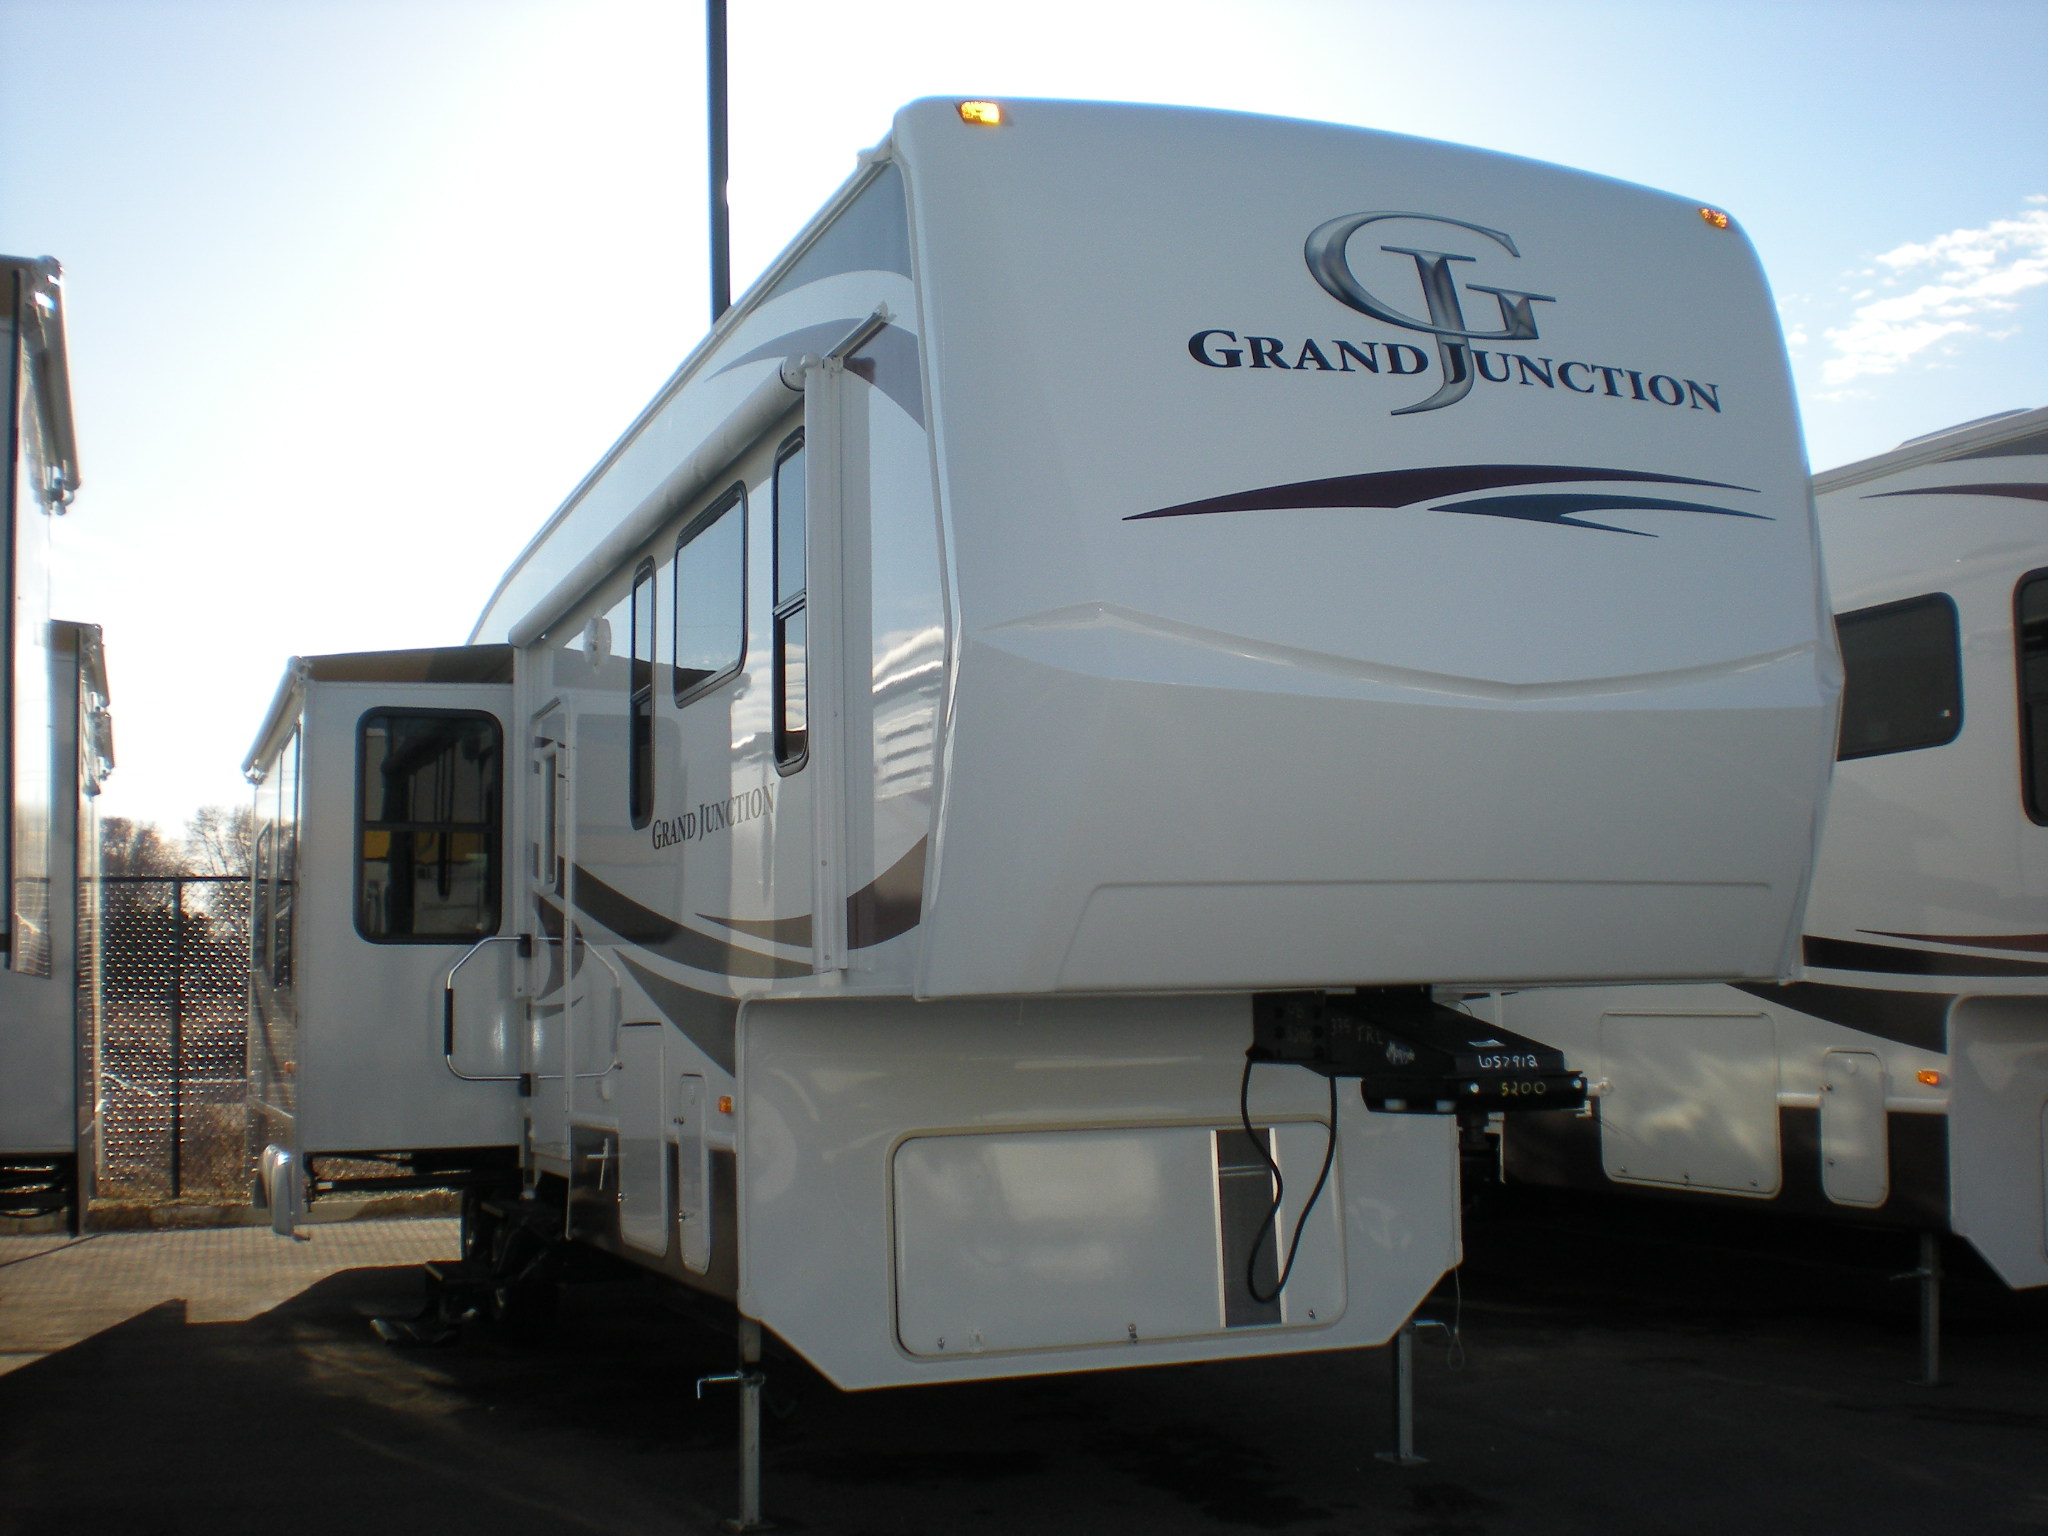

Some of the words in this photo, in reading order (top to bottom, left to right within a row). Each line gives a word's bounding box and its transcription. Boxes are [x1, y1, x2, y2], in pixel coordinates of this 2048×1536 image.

[1188, 329, 1430, 376] GRAND
[1446, 342, 1722, 414] JUNCTION
[651, 811, 697, 851] GRAND
[698, 782, 776, 843] JUNCTION
[1477, 1053, 1539, 1070] 657912
[1500, 1080, 1547, 1097] 5200
